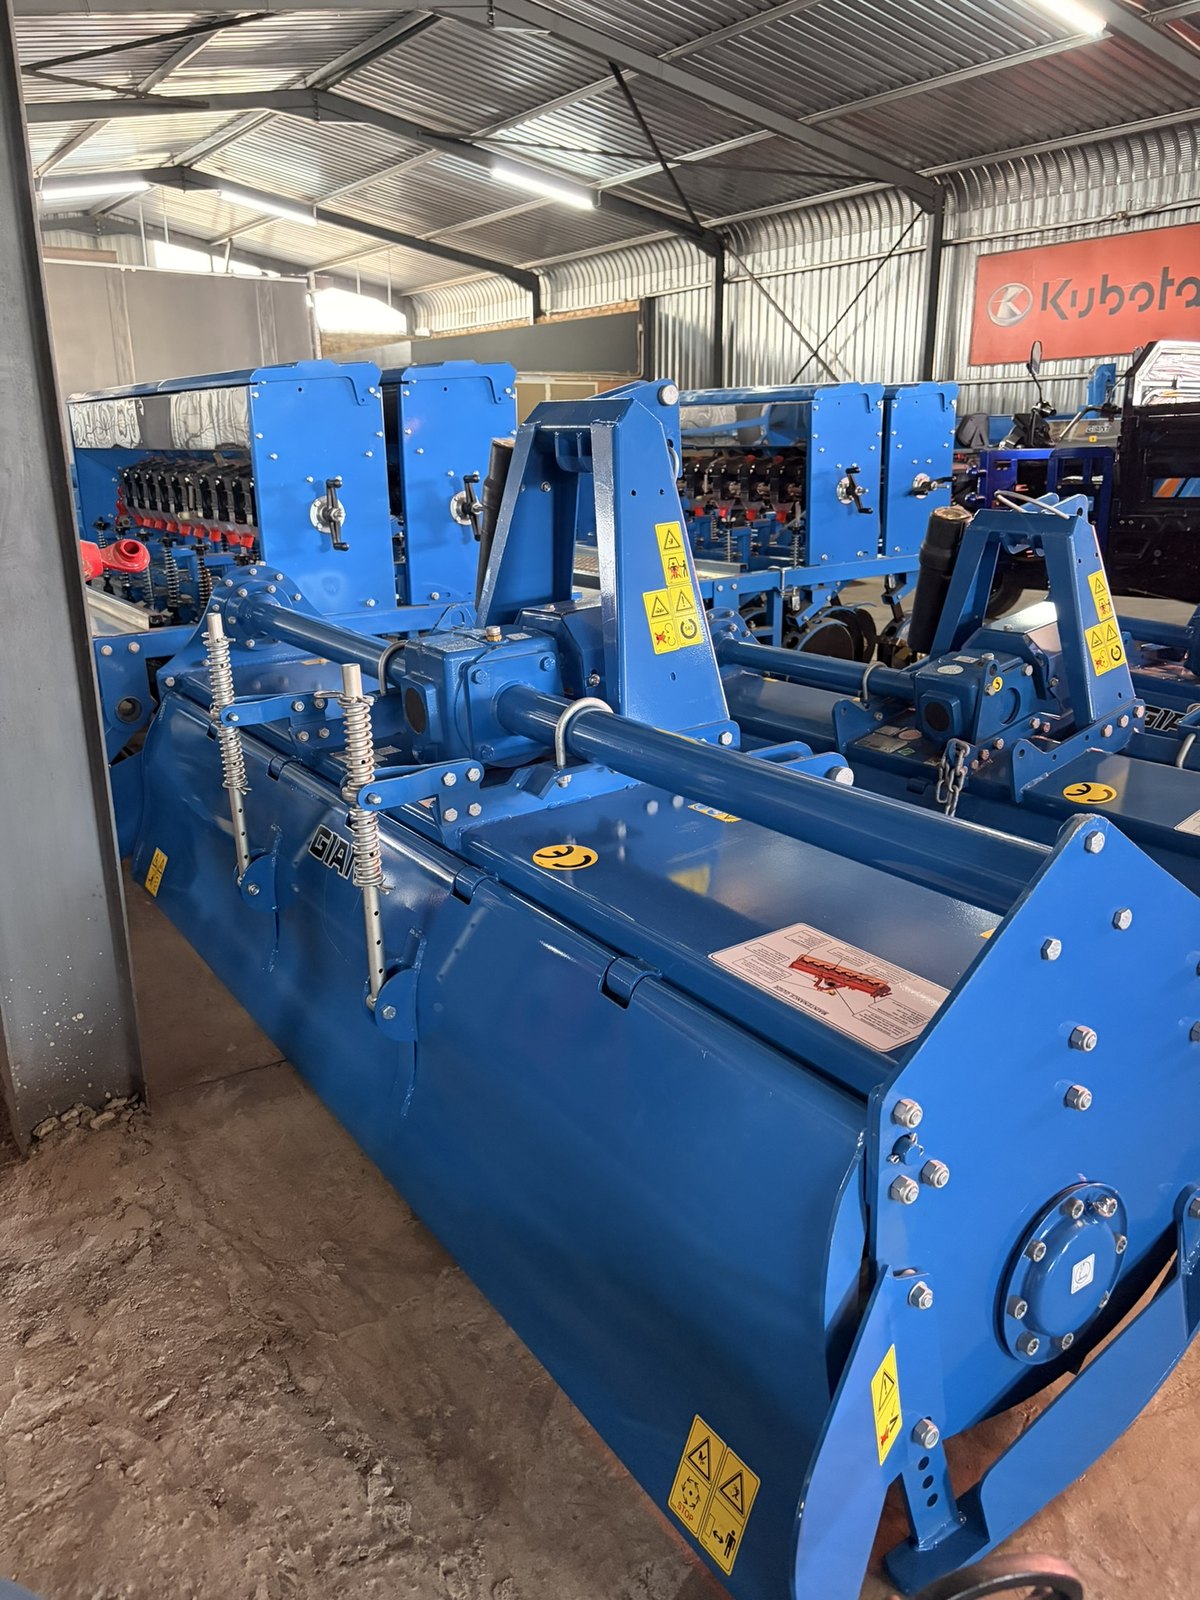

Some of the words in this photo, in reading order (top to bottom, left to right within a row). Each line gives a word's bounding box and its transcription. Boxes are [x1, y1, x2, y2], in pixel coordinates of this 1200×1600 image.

[1040, 266, 1200, 320] Kubota
[1144, 704, 1186, 732] GIA
[308, 824, 358, 885] GIA
[676, 1501, 694, 1522] STOP
